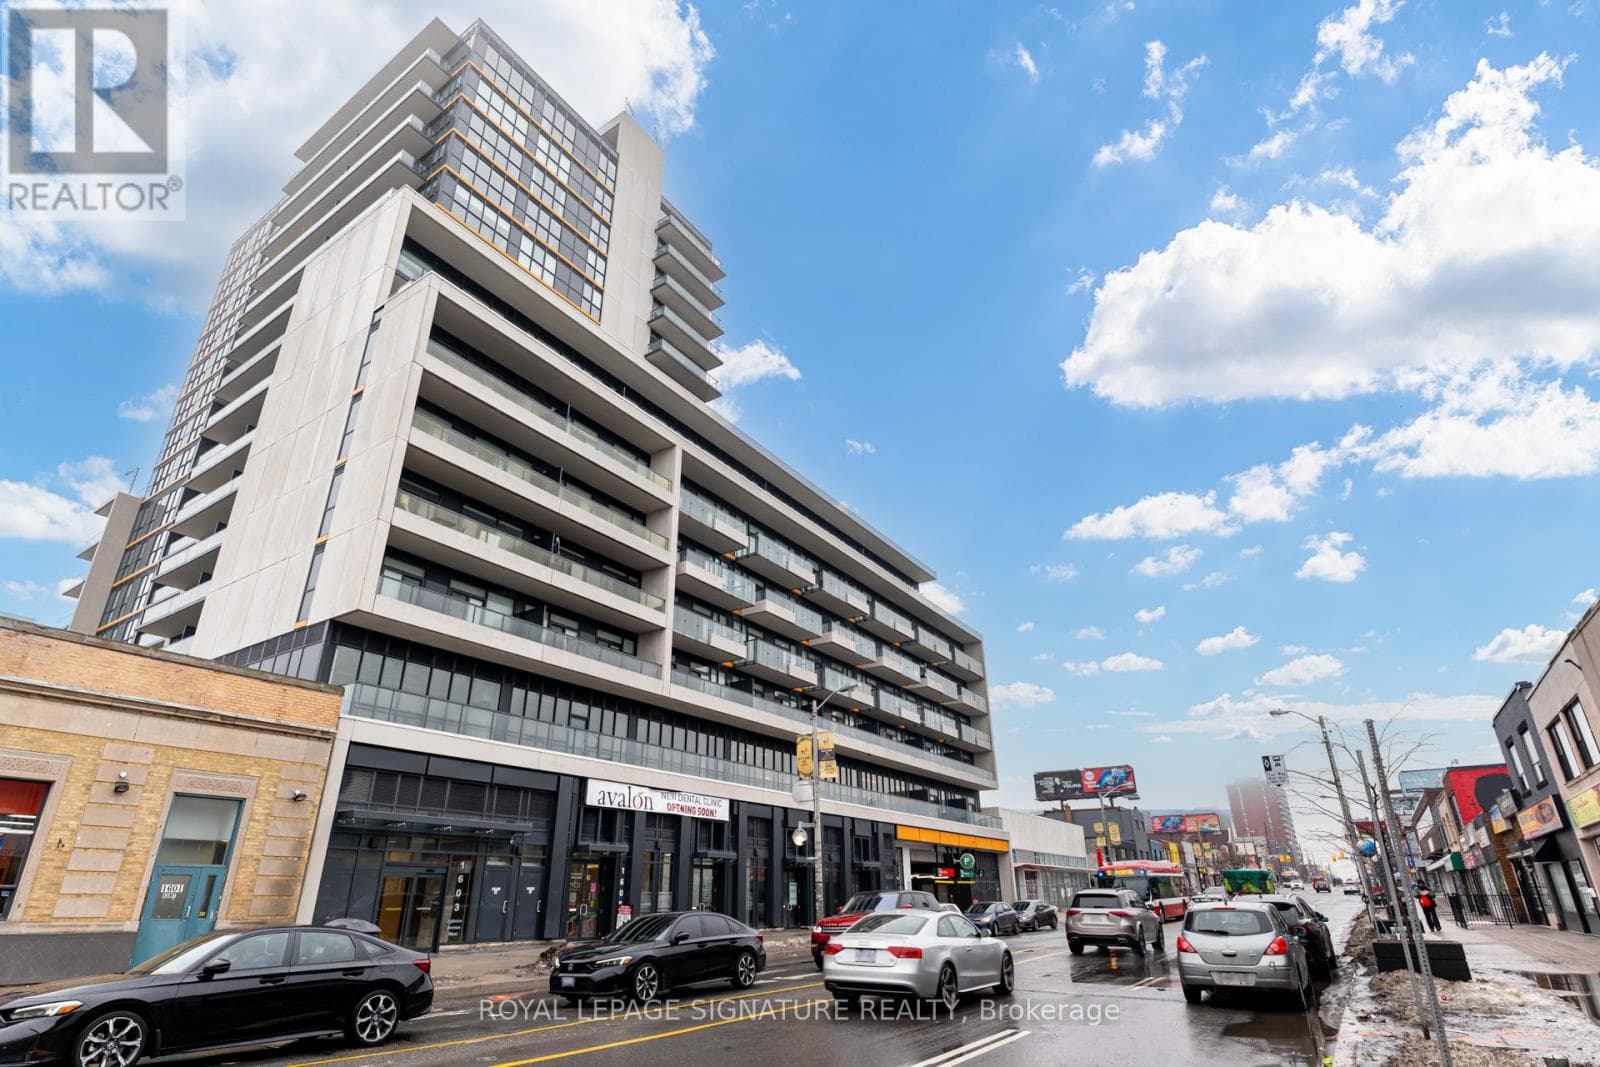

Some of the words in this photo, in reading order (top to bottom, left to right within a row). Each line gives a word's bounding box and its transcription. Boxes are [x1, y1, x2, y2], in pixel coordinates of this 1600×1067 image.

[661, 791, 677, 802] NEW
[678, 793, 703, 805] DENTAL
[703, 797, 722, 808] CLINIC
[666, 802, 697, 815] OPENING
[697, 806, 717, 817] SOON!
[454, 861, 465, 912] 1603
